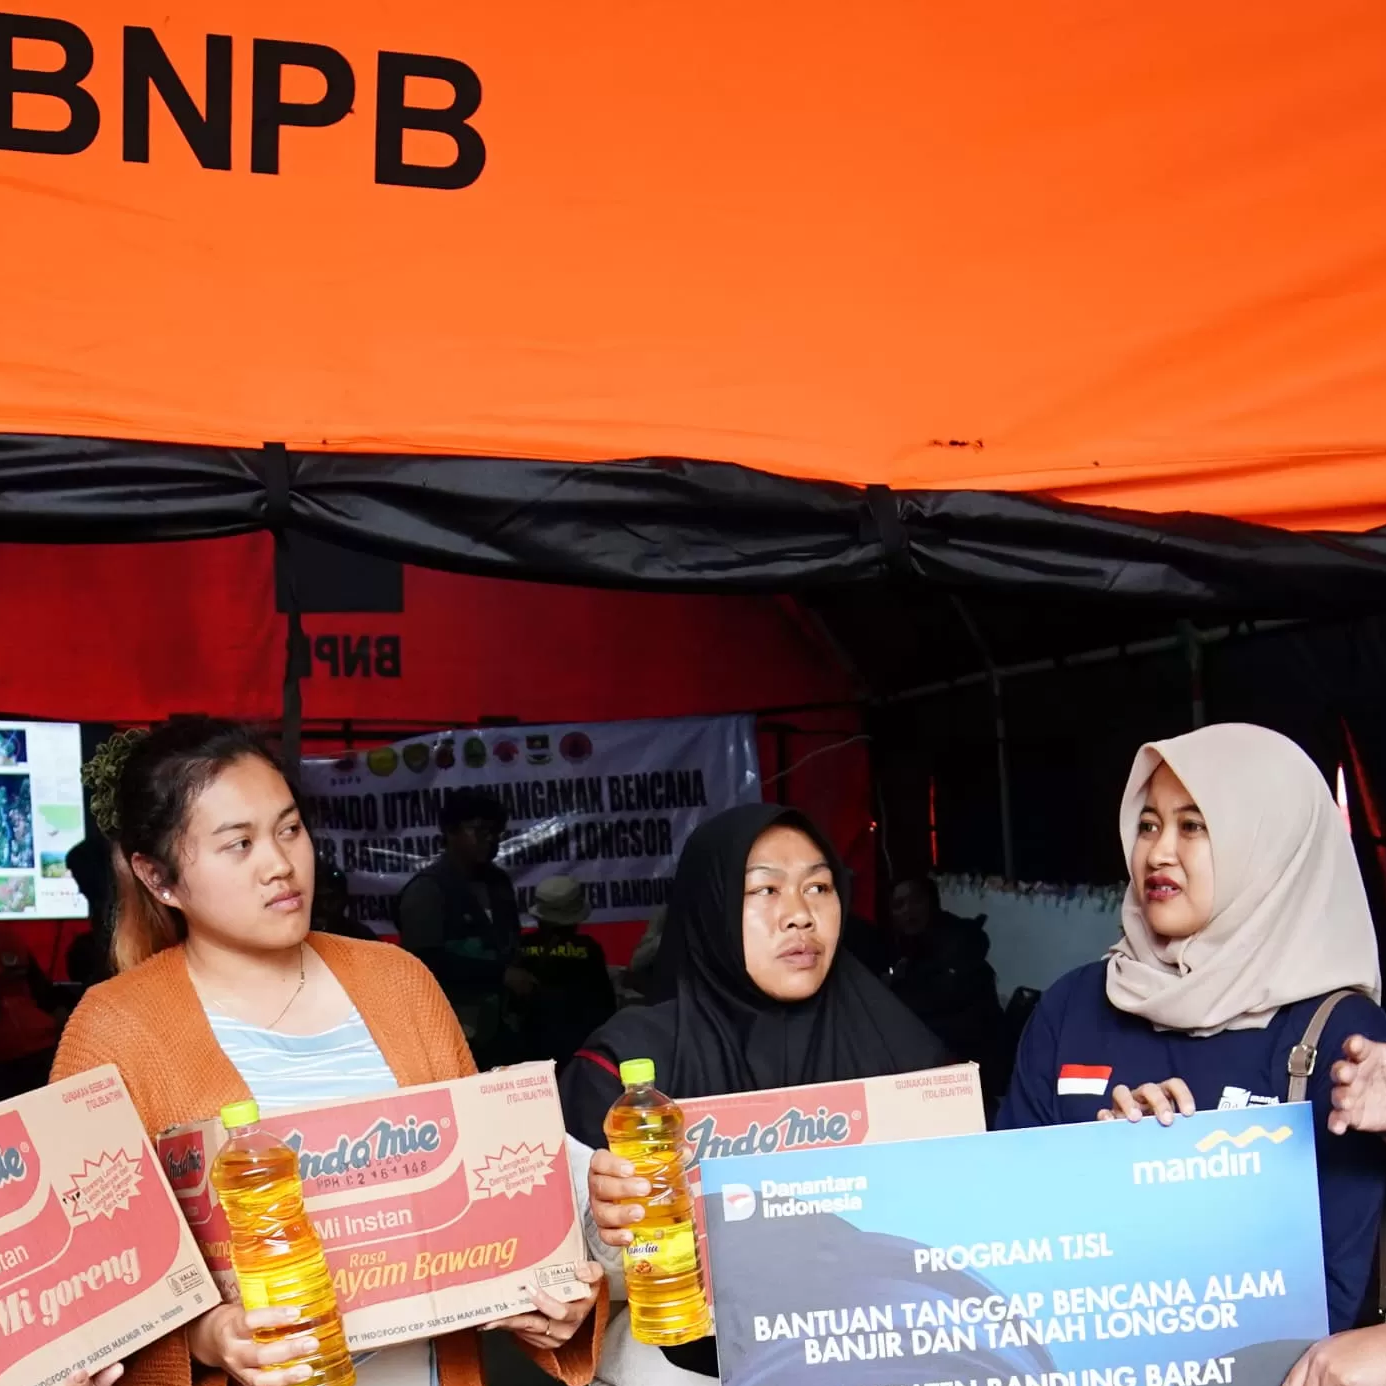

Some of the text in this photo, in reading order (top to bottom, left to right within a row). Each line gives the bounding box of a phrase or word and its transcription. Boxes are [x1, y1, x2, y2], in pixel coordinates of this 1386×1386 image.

[383, 786, 449, 829] UTAM
[459, 776, 603, 824] ANGANAN
[608, 769, 708, 812] BENCANA
[576, 818, 673, 860] LONGSOR
[611, 876, 677, 909] BANDU
[1133, 1147, 1261, 1185] mandiri
[762, 1175, 868, 1198] Danantara
[315, 1208, 413, 1241] Mi Instan
[763, 1193, 863, 1219] Indonesia
[332, 1238, 518, 1302] Ayam Bawang
[349, 1250, 387, 1267] Rasa
[914, 1233, 1114, 1274] PROGRAM TJSL
[39, 1247, 141, 1328] goreng
[753, 1269, 1287, 1343] BANTUAN TANGGAP BENCANA ALAM
[362, 1325, 406, 1342] INDOFOOD
[804, 1302, 1239, 1367] BANJIR DAN TANAH LONGSOR
[87, 1345, 112, 1364] SUKSES
